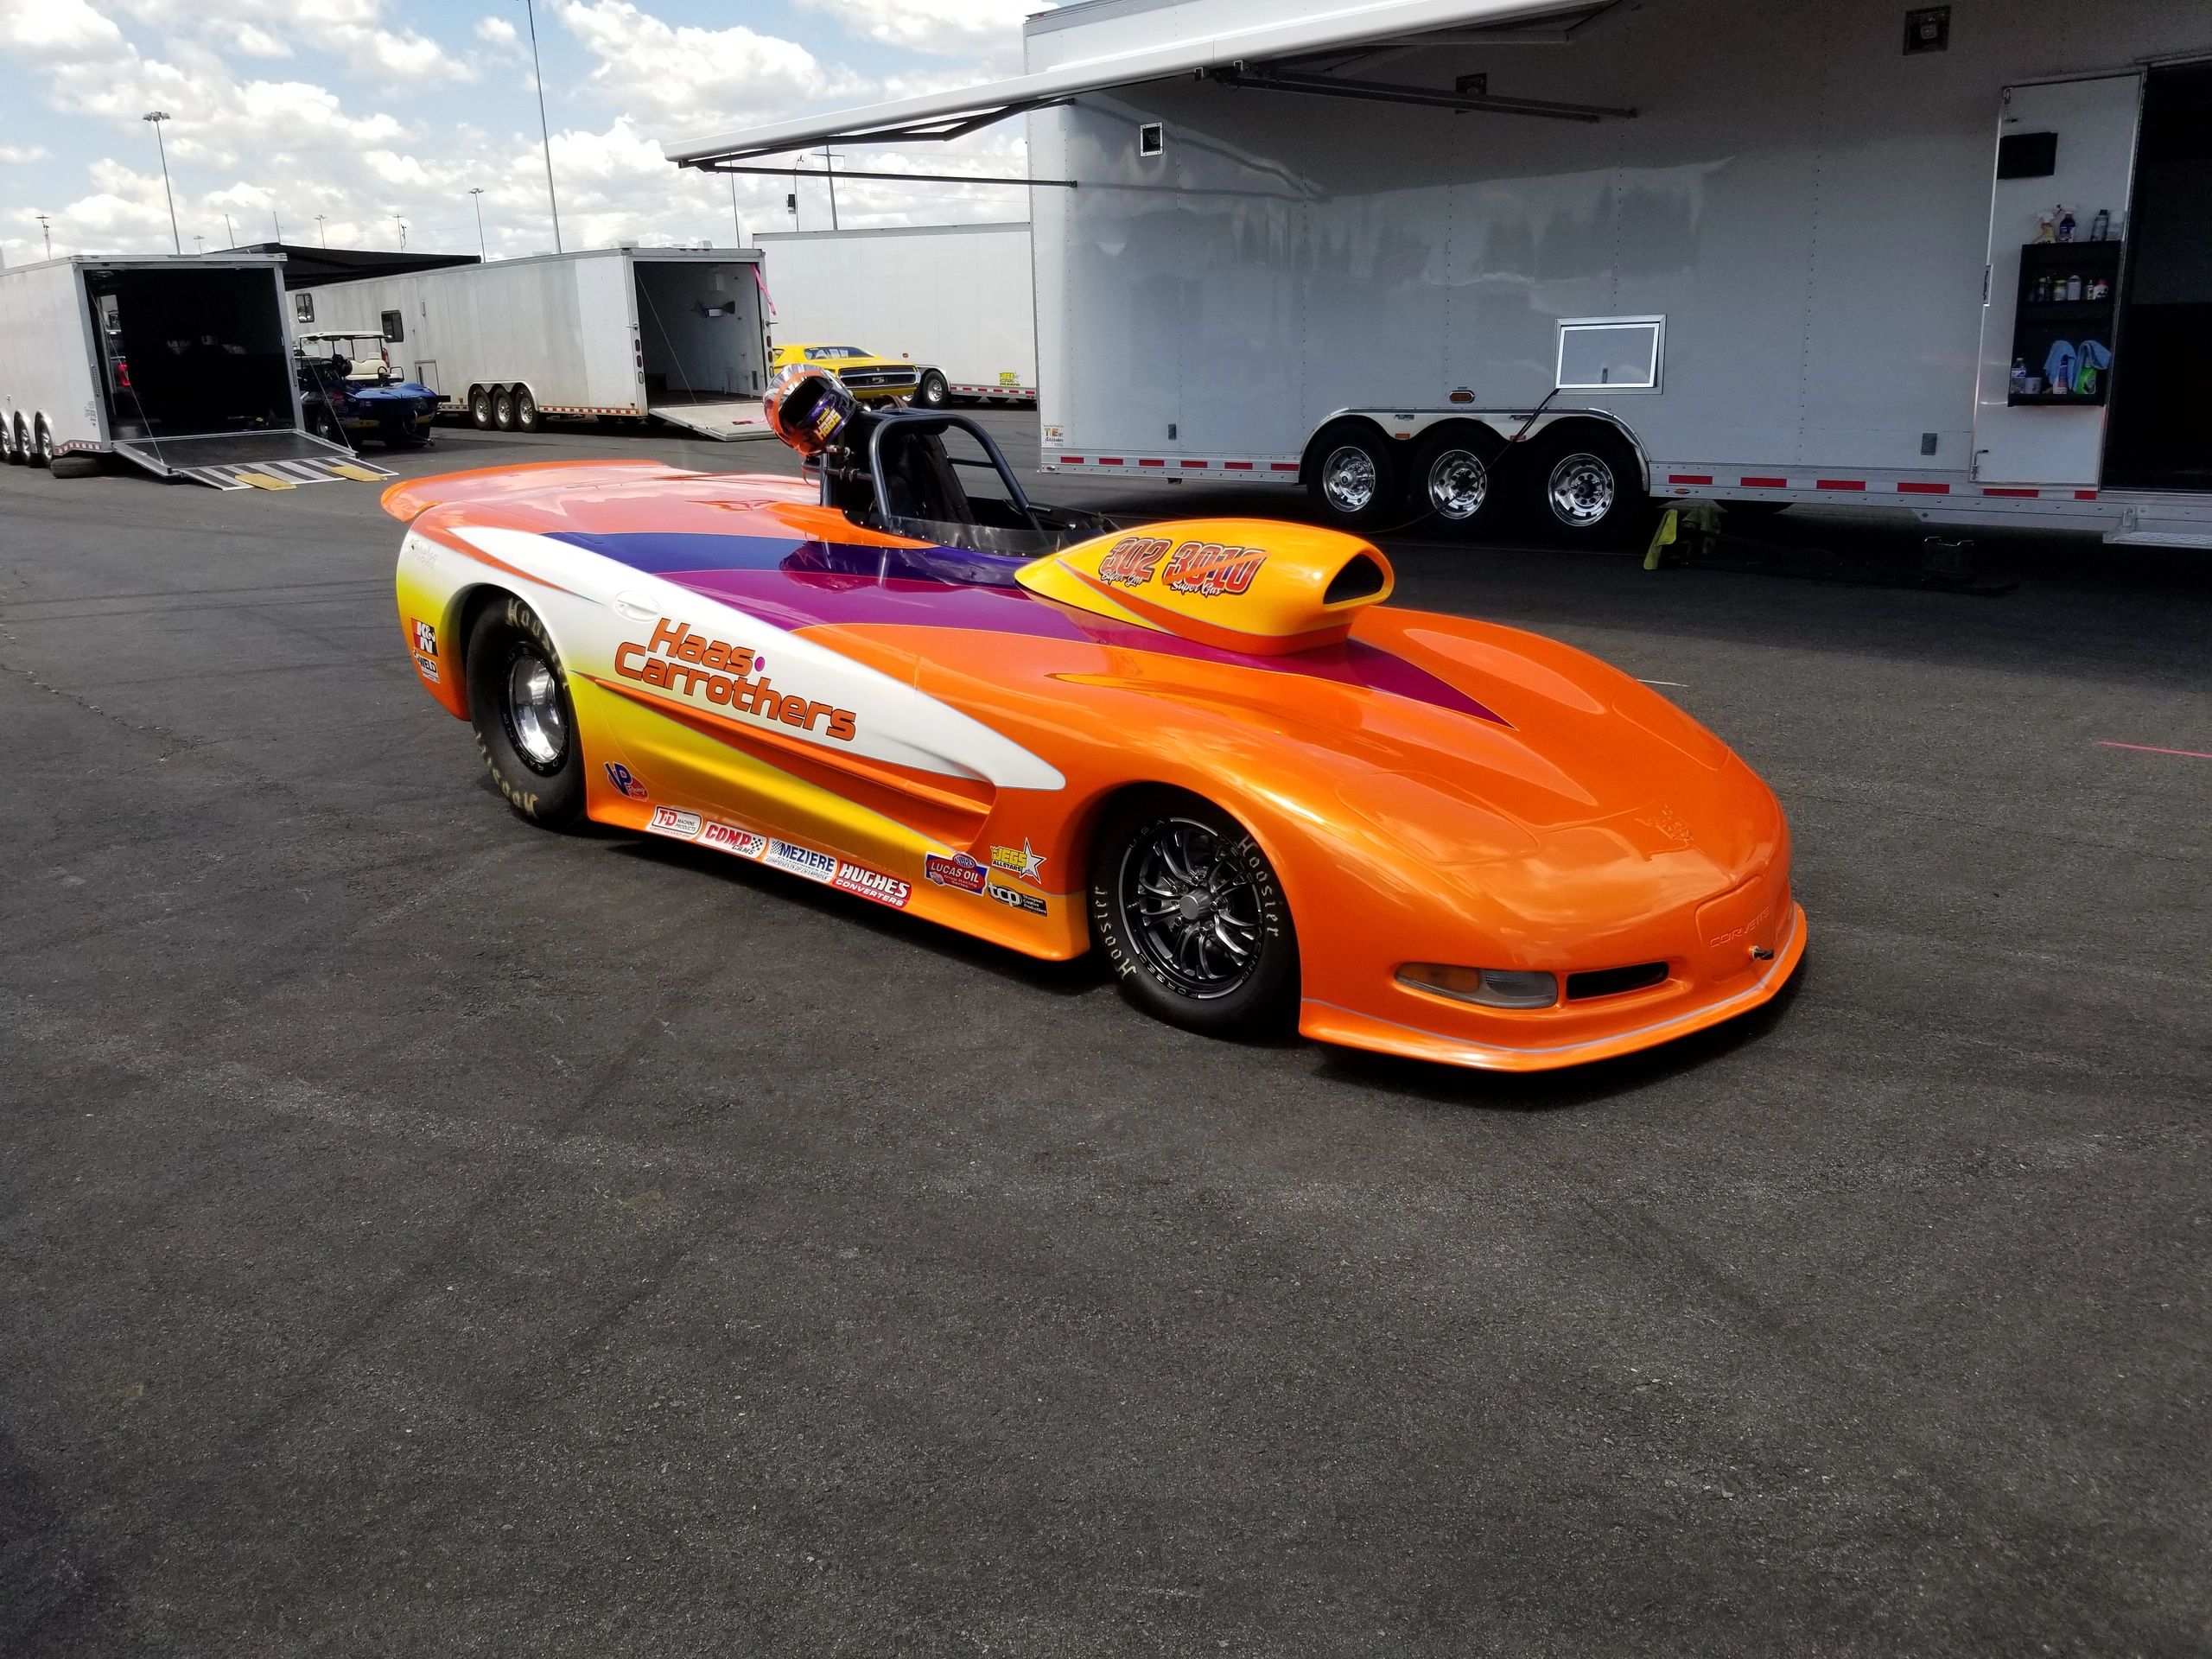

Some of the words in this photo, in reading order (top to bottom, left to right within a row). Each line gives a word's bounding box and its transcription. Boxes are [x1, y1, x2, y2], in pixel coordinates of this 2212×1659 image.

[1099, 537, 1172, 582] 302
[1101, 571, 1123, 585] Super
[1170, 580, 1199, 594] Super
[1201, 582, 1224, 599] Gas
[647, 618, 755, 677] Haas
[614, 641, 856, 741] Carrothers
[604, 762, 632, 797] VP
[675, 823, 696, 832] PRODUCTS
[677, 818, 696, 827] MACHINE
[704, 824, 753, 848] COMP
[731, 844, 756, 855] CAMS
[779, 842, 836, 873] MEZIERE
[954, 855, 975, 868] NHRA
[993, 847, 1027, 868] JEGS
[931, 861, 963, 878] LUCAS
[963, 871, 979, 883] OIL
[993, 860, 1022, 872] ALLSTARS
[835, 879, 905, 907] CONVERTERS
[838, 864, 910, 899] HUGHES
[988, 881, 1020, 907] tcp
[1237, 834, 1280, 938] Hoosier
[1093, 885, 1137, 980] Hoosier
[1709, 907, 1770, 949] CORVETTE
[1139, 953, 1198, 999] FORGED
